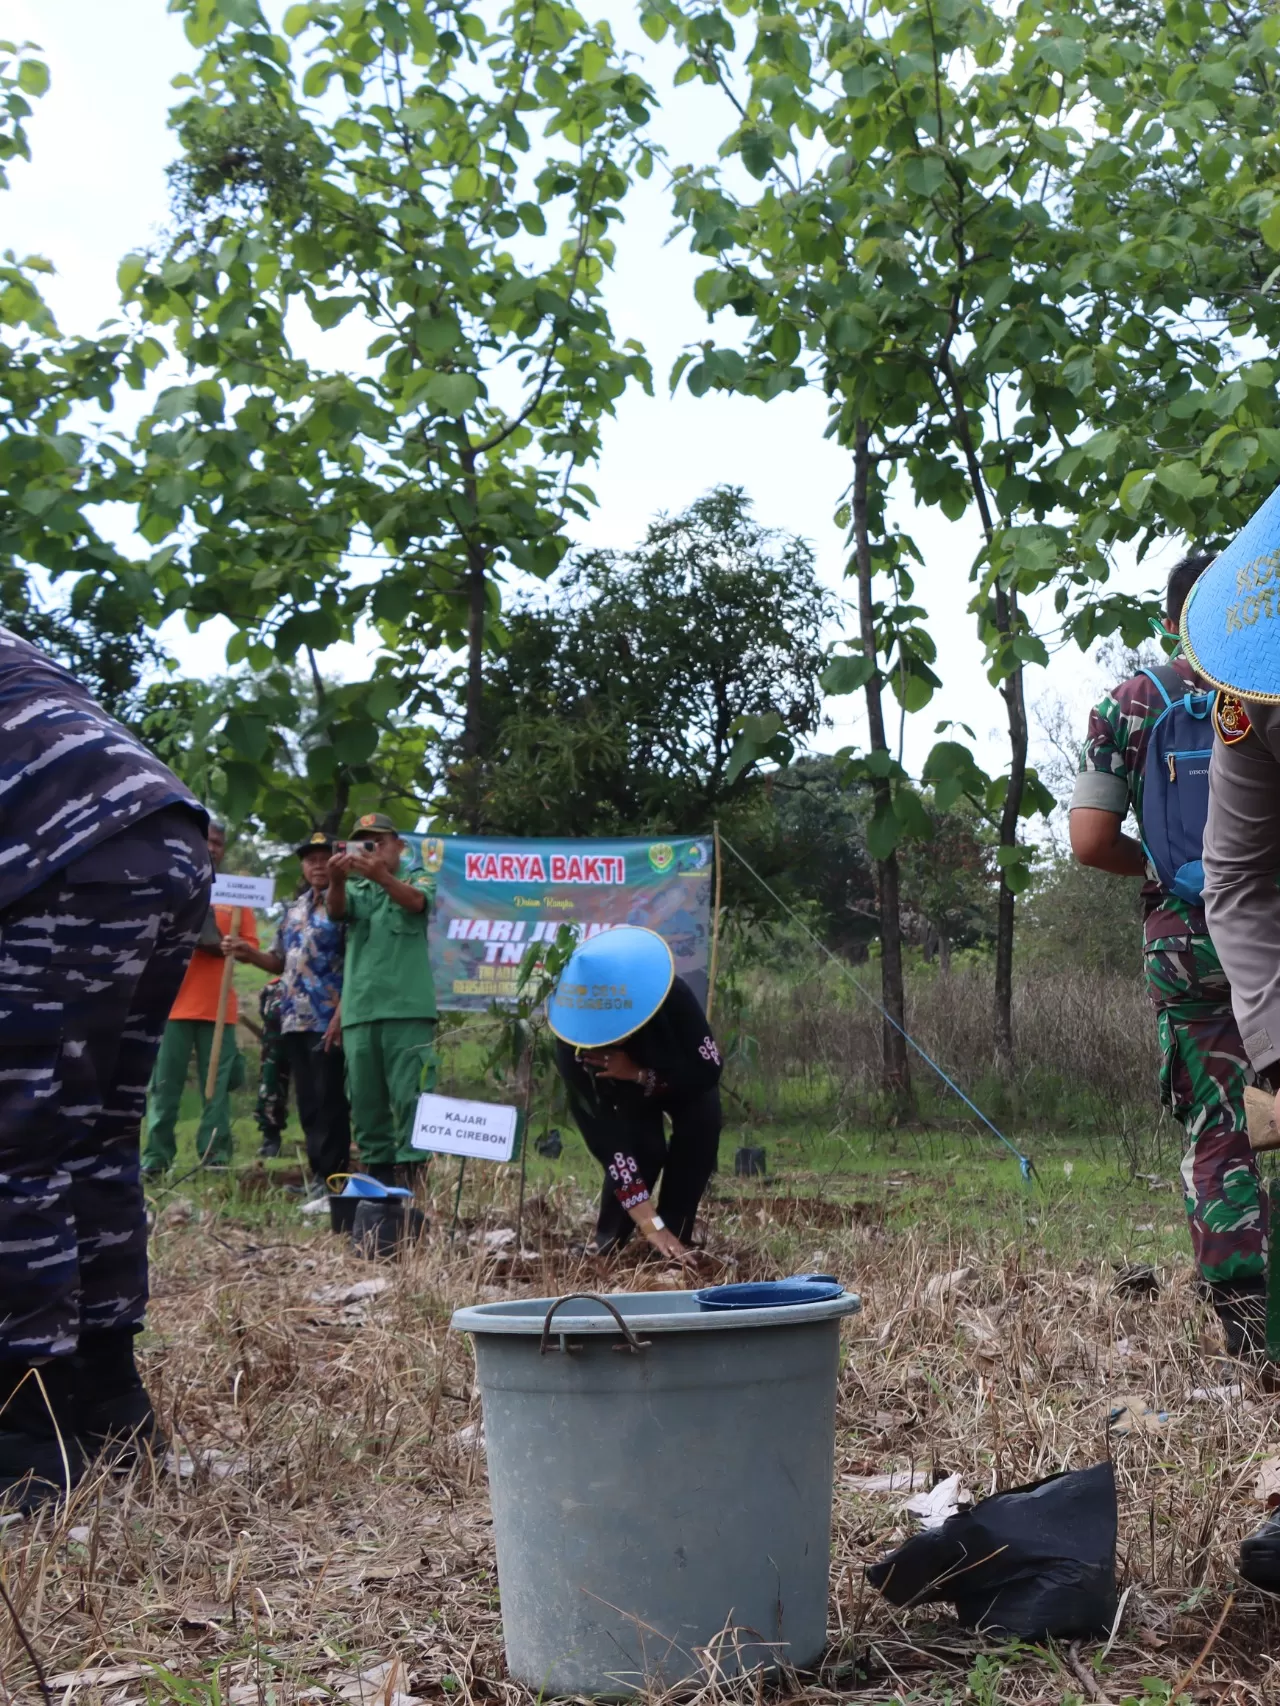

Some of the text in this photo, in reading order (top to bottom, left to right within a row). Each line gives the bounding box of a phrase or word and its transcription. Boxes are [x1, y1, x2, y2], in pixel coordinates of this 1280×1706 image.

[465, 853, 626, 885] KARYA BAKTI
[447, 919, 527, 942] HARI
[445, 1112, 487, 1126] KAJARI
[420, 1124, 507, 1145] KOTA CIREBON
